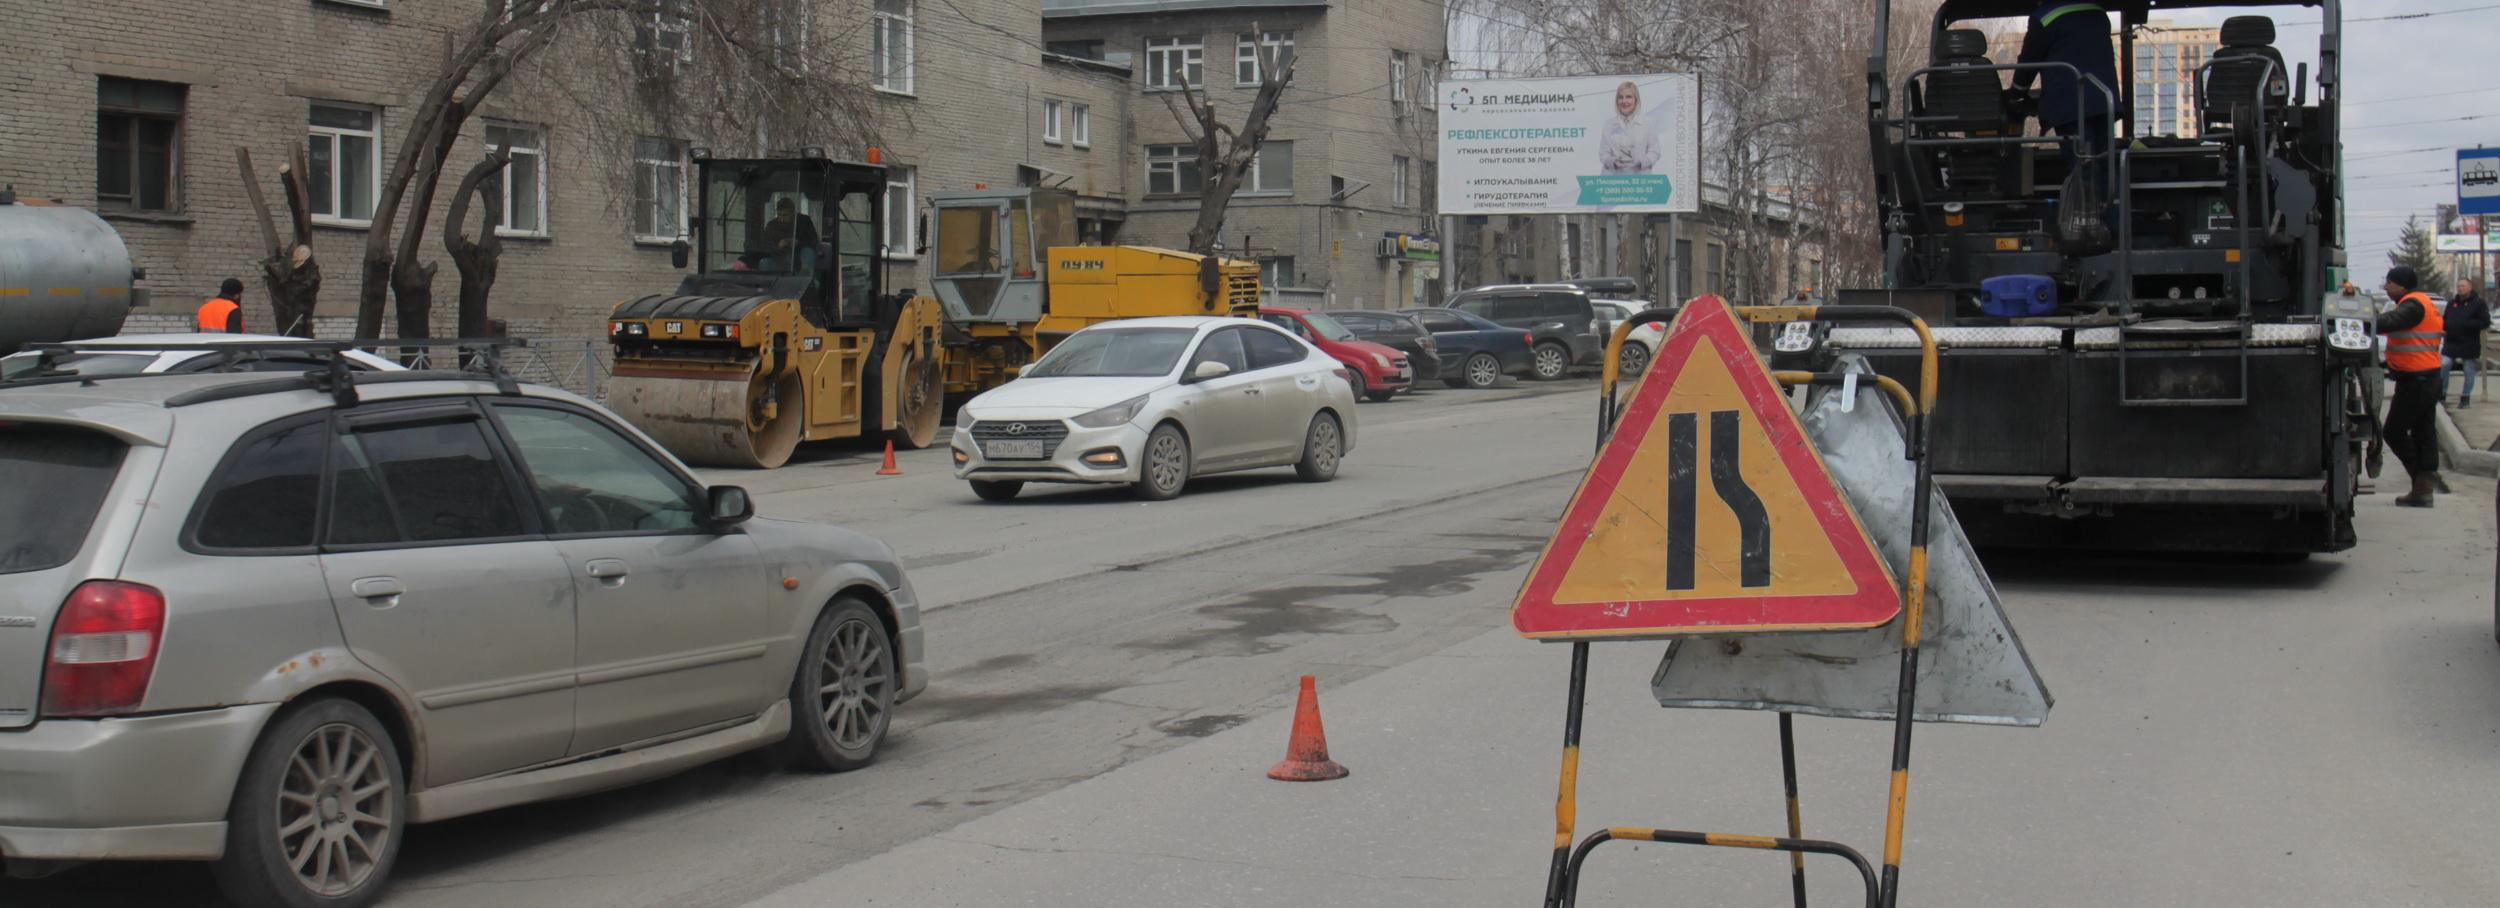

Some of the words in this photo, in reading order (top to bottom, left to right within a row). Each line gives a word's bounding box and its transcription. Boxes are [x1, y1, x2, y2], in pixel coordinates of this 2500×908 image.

[1504, 93, 1575, 105] МЕДИЦИНА
[1447, 127, 1587, 140] РЕФЛЕКСОТЕРАПЕВТ
[1457, 147, 1489, 155] УТКИНА
[1527, 146, 1575, 154] СЕРГЕЕВНА
[1473, 178, 1558, 186] ИГЛОУКАЛЫВАНИЕ
[1473, 192, 1548, 201] ГИРУДОТЕРАПИЯ
[667, 323, 681, 332] CAT
